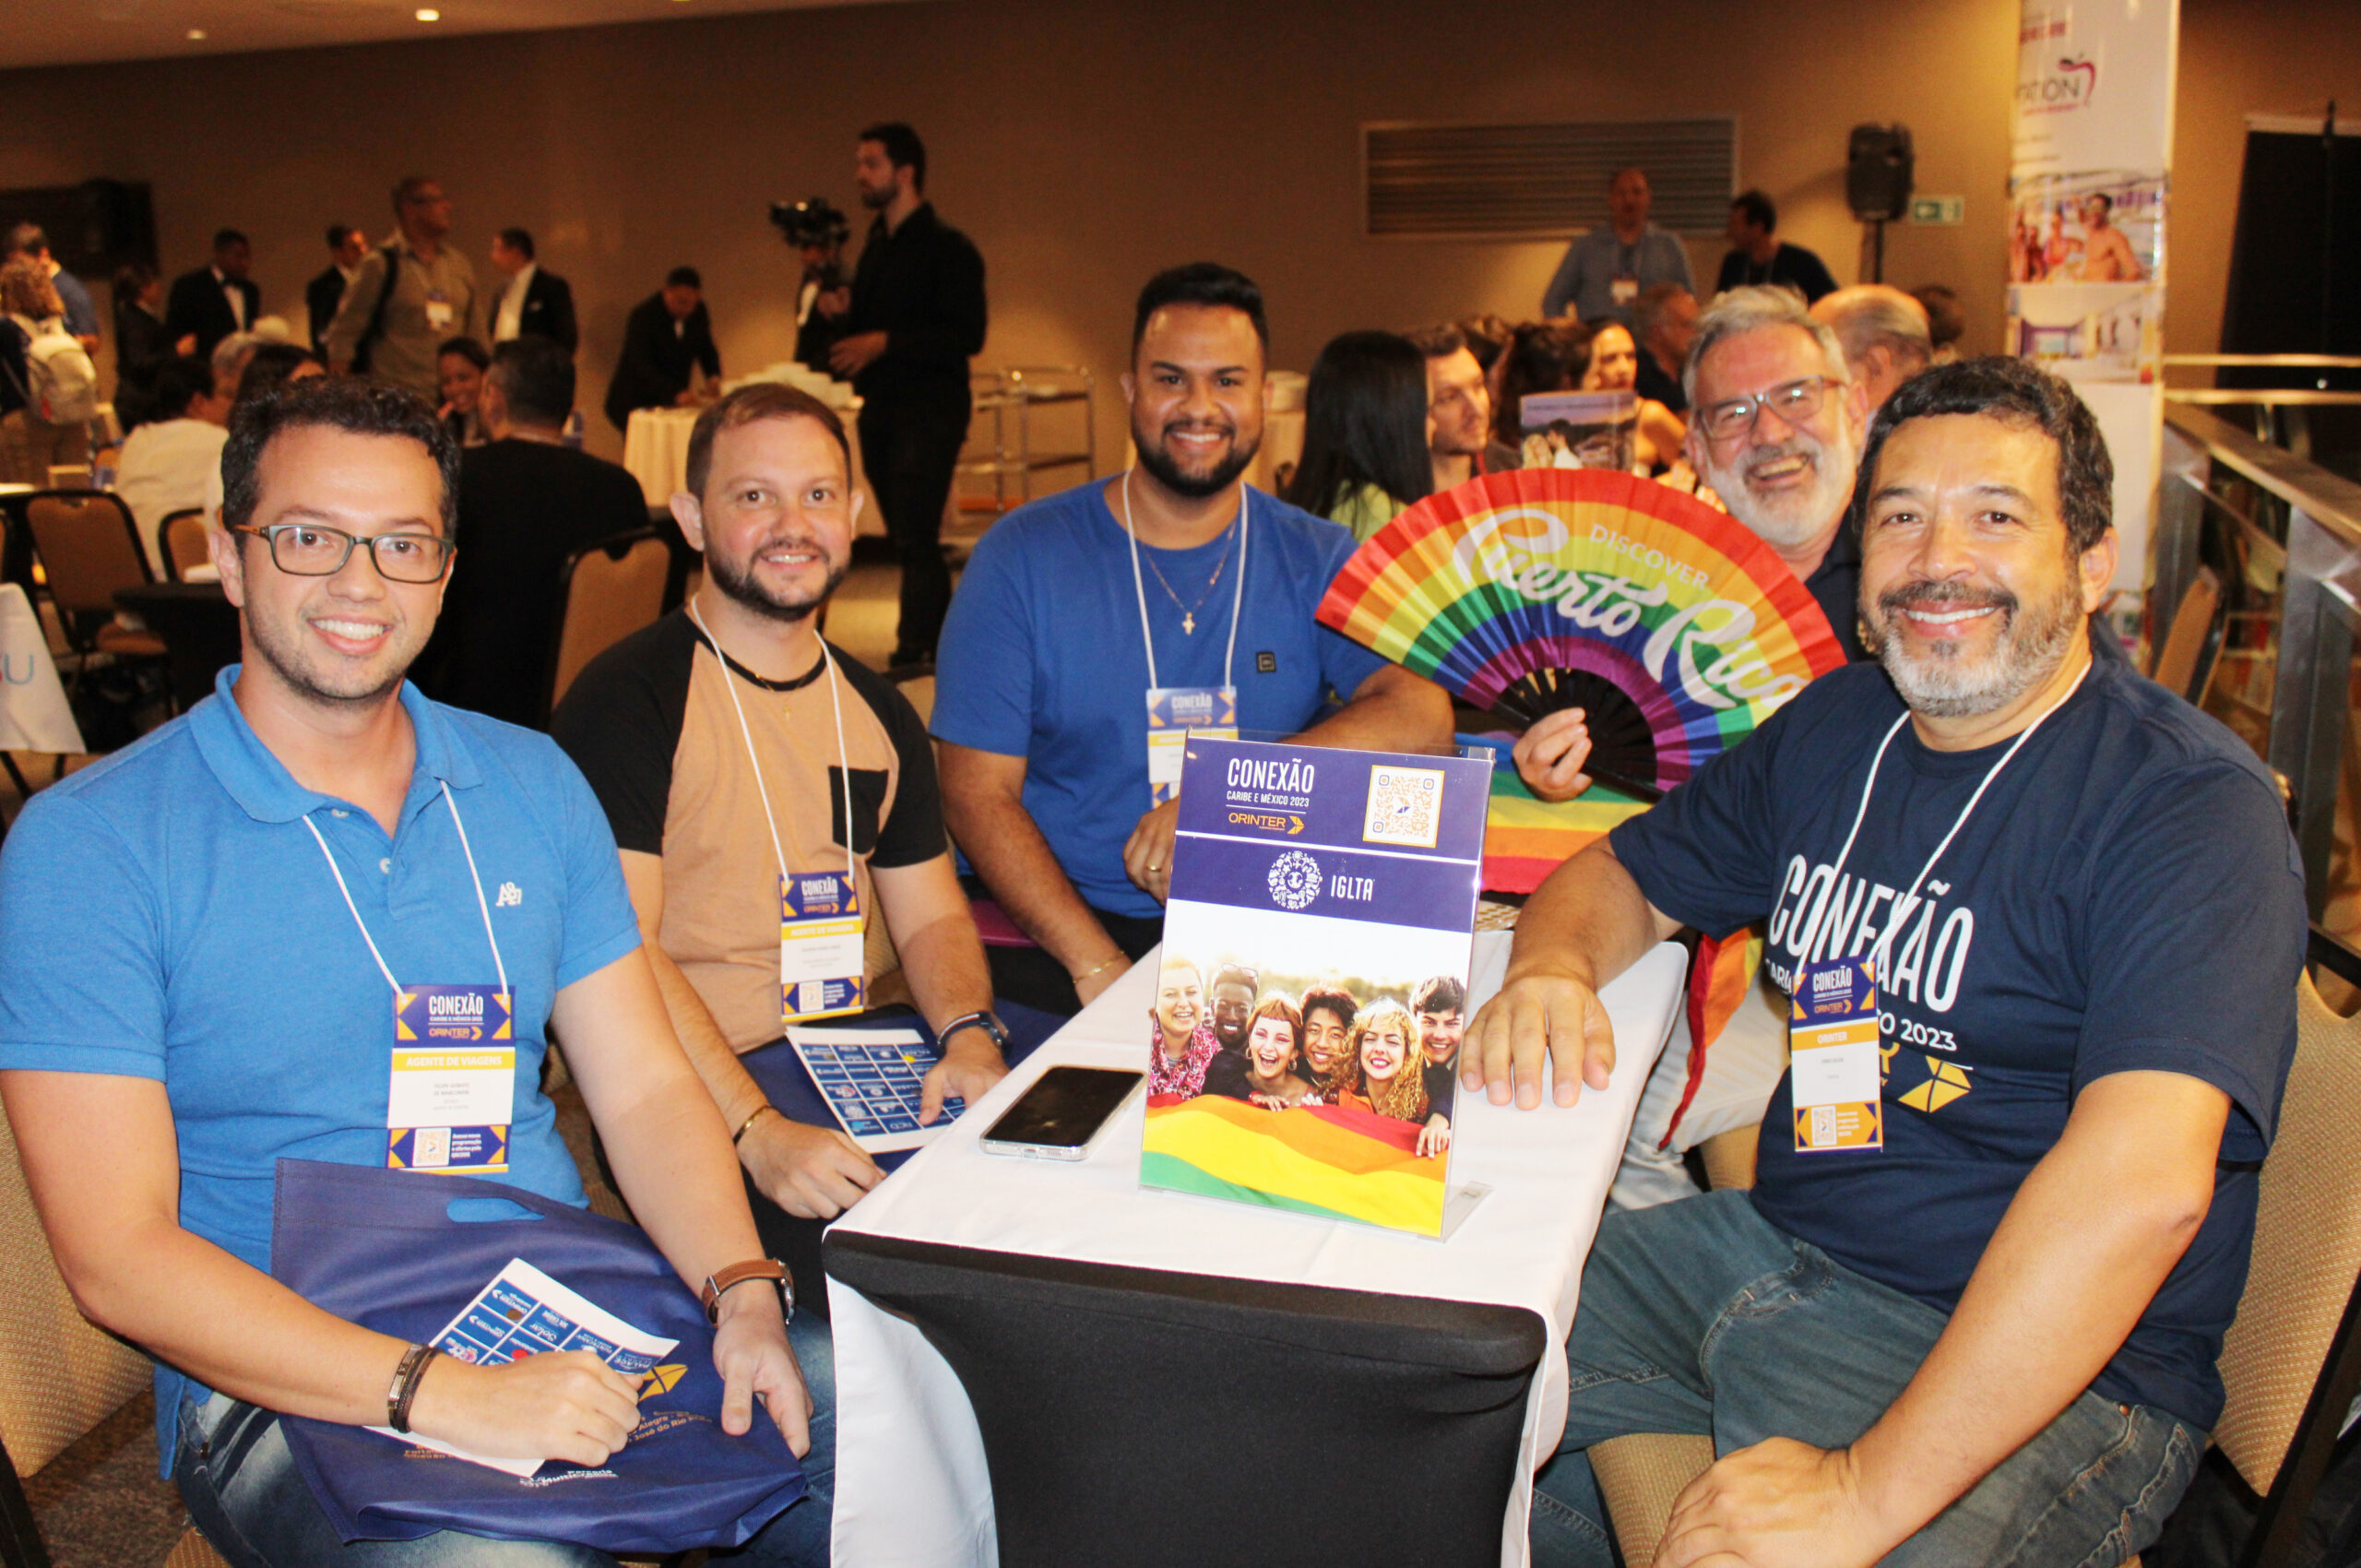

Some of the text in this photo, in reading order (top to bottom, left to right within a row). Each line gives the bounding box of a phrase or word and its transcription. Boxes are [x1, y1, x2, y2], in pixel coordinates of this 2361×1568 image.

[1588, 522, 1710, 591] DISCOVER
[1453, 508, 1810, 709] Puerto Rico
[1227, 757, 1315, 793] CONEXÃO
[1226, 790, 1310, 807] CARIBE E MÉXICO 2023
[1228, 812, 1287, 828] ORINTER
[801, 876, 838, 896] CONEXÃO
[1330, 874, 1374, 901] IGLTA
[1769, 854, 1975, 1013] CONEXÃO
[1812, 965, 1853, 992] CONEXÃO
[428, 992, 484, 1016] CONEXÃO
[428, 1028, 470, 1038] ORINTER
[1817, 1031, 1848, 1044] ORINTER
[1900, 1018, 1958, 1051] 2023
[406, 1055, 503, 1067] AGENTE DE VIAGENS
[499, 1293, 528, 1314] ORINTER
[635, 1428, 656, 1441] José
[657, 1423, 670, 1432] do
[670, 1417, 687, 1427] Rio
[639, 1416, 669, 1431] Alegre
